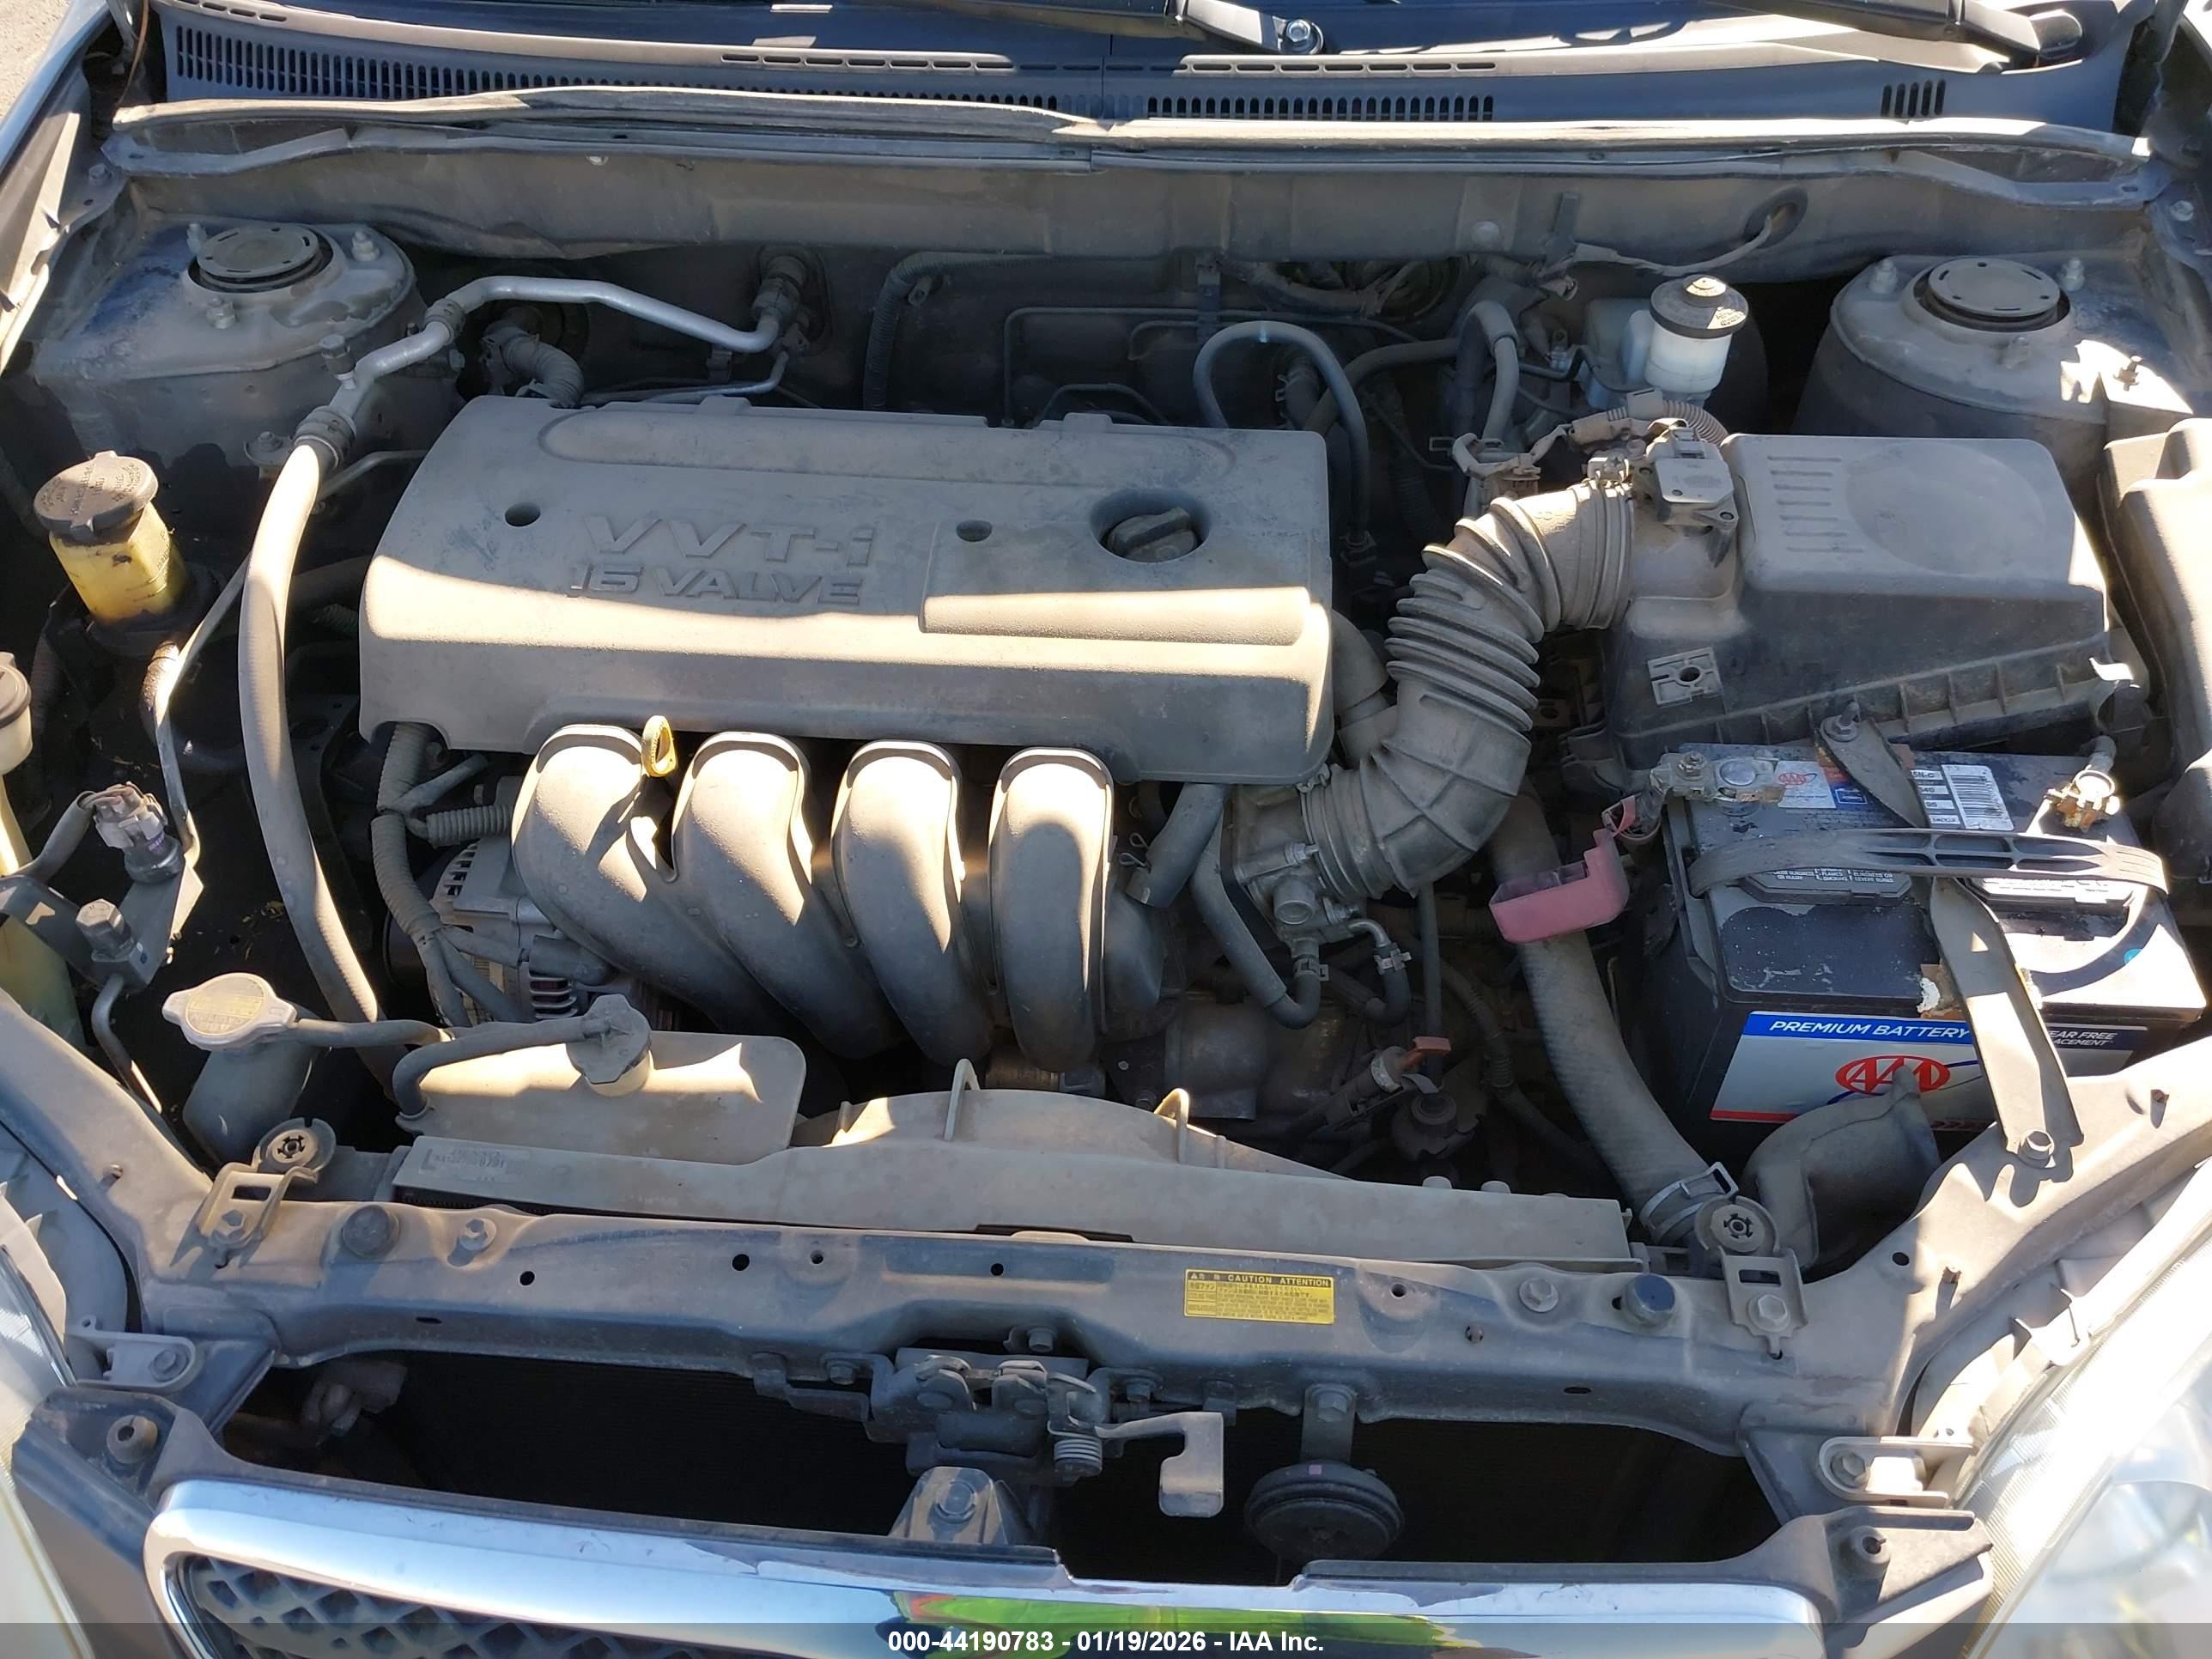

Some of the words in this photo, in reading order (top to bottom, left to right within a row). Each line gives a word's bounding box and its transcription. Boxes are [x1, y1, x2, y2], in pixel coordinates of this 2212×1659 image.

[582, 515, 874, 567] VVT-i
[567, 562, 643, 595] 16
[653, 568, 862, 605] VALVE
[1769, 1020, 1872, 1035] PREMIUM
[1872, 1024, 1971, 1038] BATTERY
[2077, 1031, 2118, 1040] FREE
[1228, 1274, 1273, 1284] CAUTION
[1279, 1277, 1329, 1286] ATTENTION
